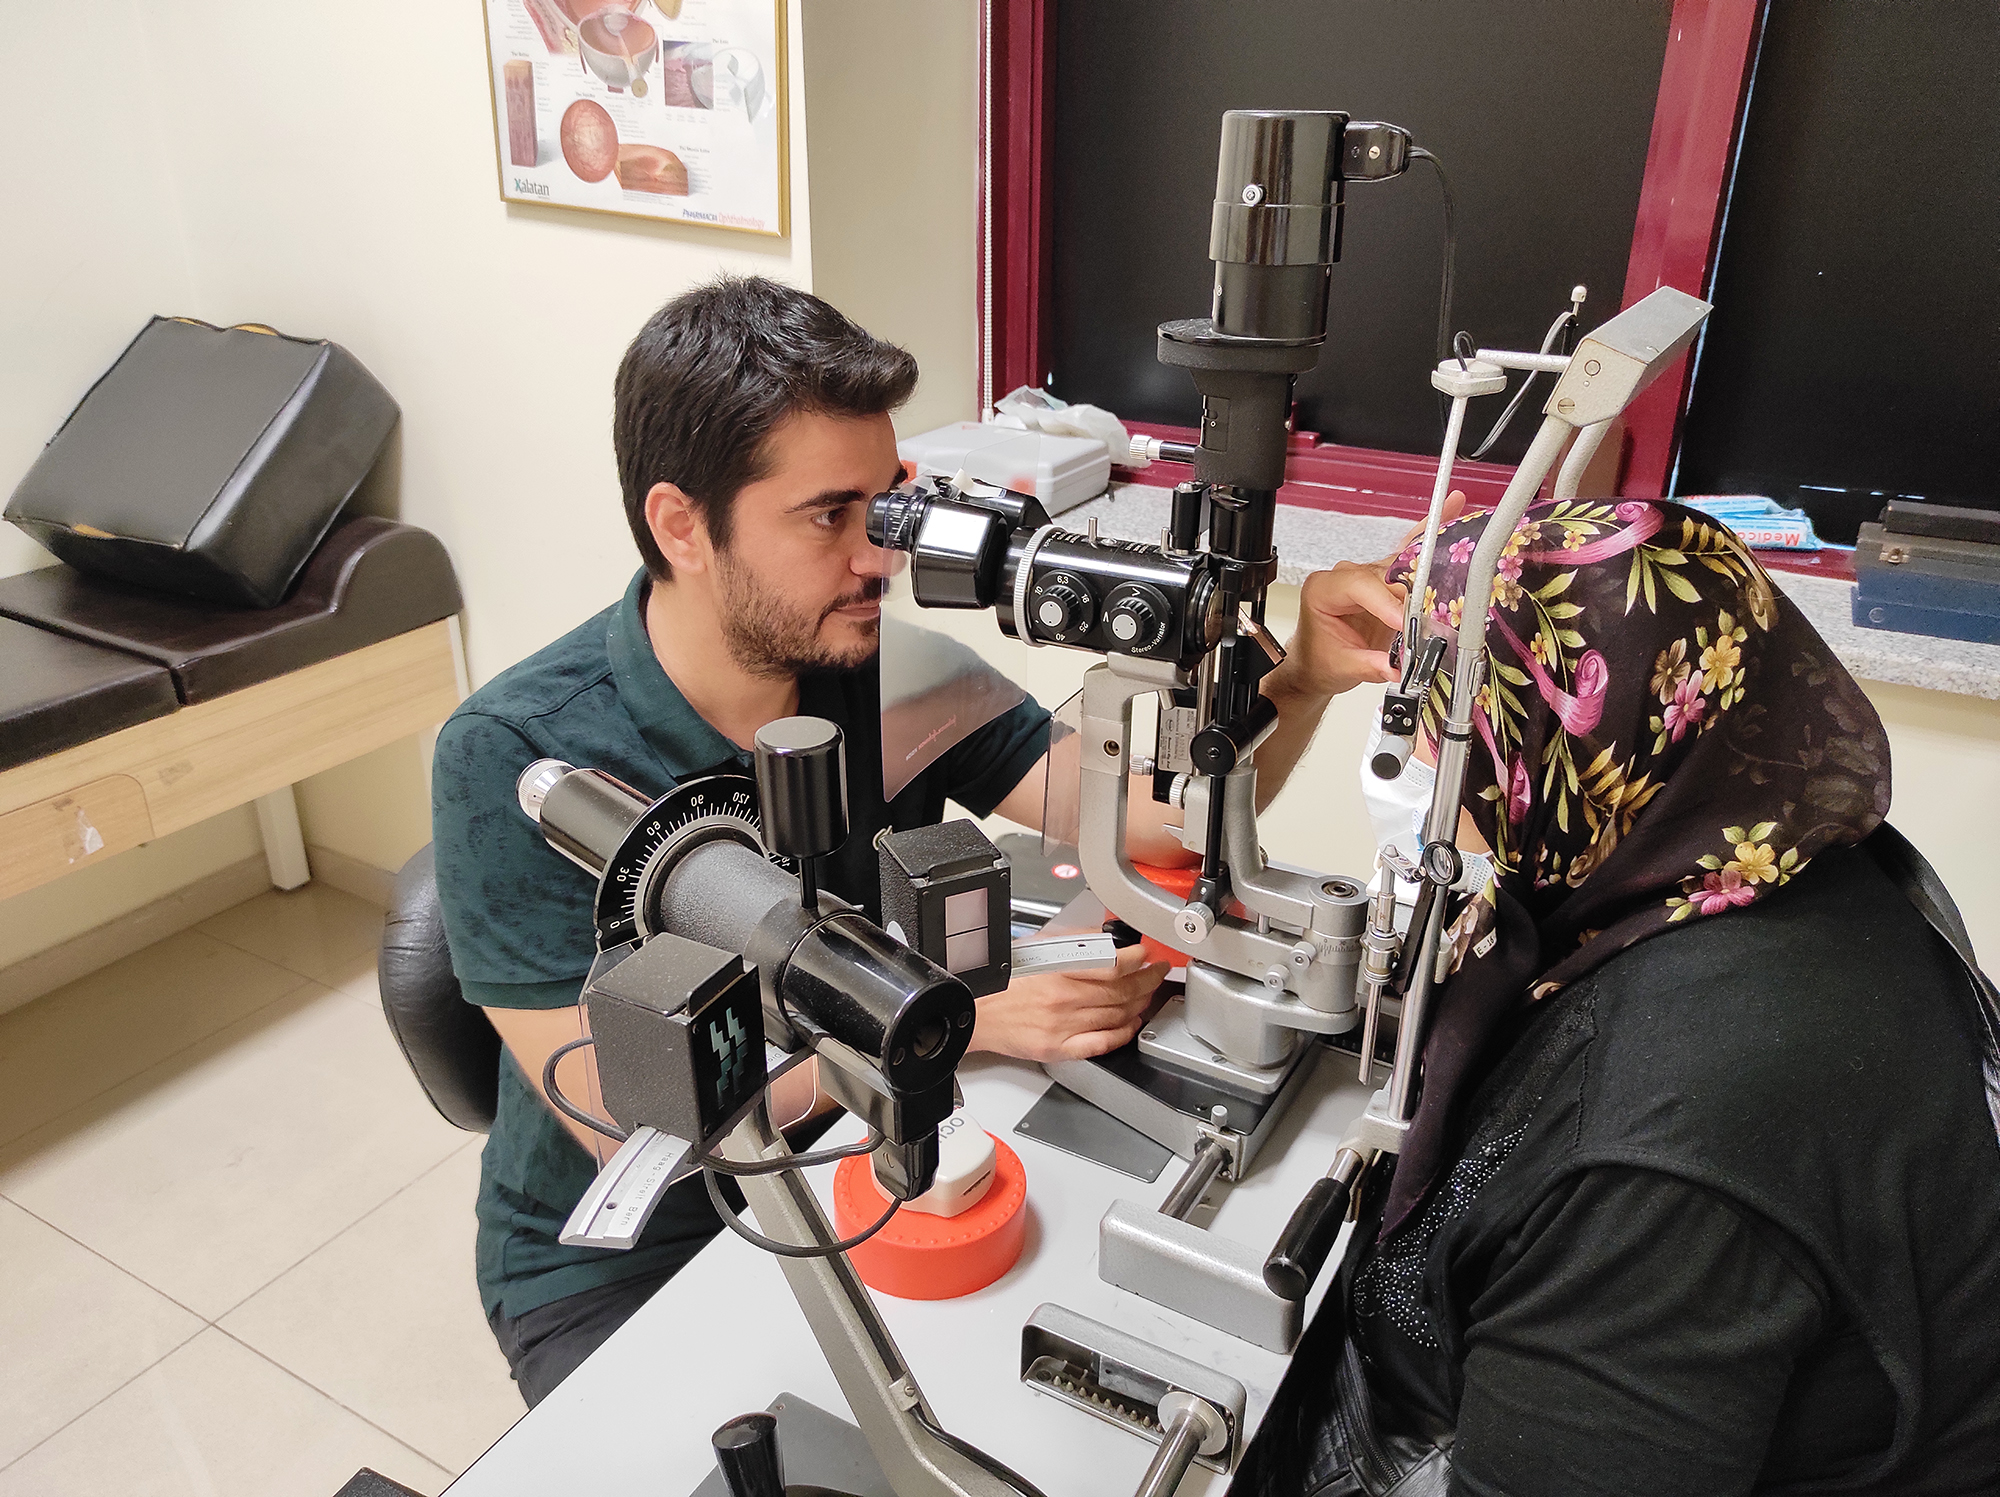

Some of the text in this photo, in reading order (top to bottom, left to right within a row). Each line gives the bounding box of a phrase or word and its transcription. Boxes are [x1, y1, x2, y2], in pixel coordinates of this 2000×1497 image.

[514, 177, 550, 196] Xalatan
[1034, 586, 1043, 596] 10
[1079, 620, 1089, 633] 25
